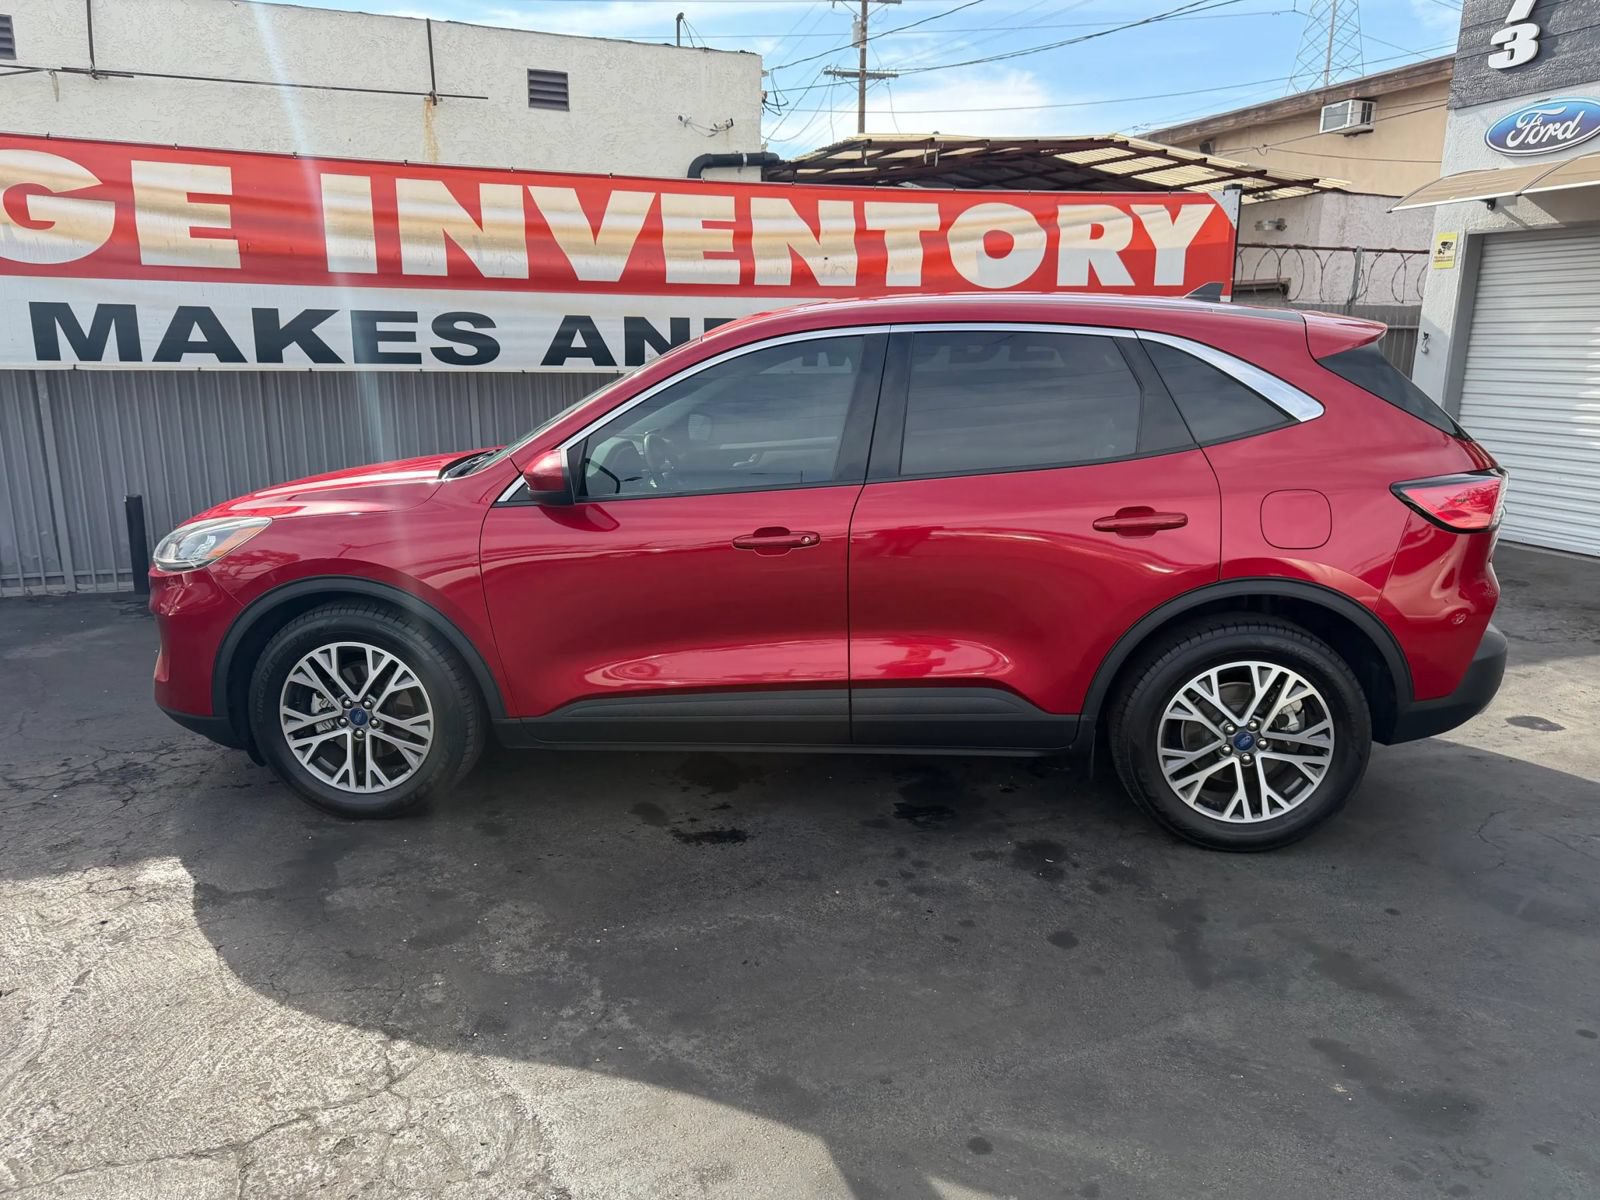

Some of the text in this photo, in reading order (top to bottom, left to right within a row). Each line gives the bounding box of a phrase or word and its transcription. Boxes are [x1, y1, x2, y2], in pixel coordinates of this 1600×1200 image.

[1506, 106, 1584, 147] Ford
[320, 172, 1215, 288] INVENTORY
[28, 301, 500, 366] MAKES
